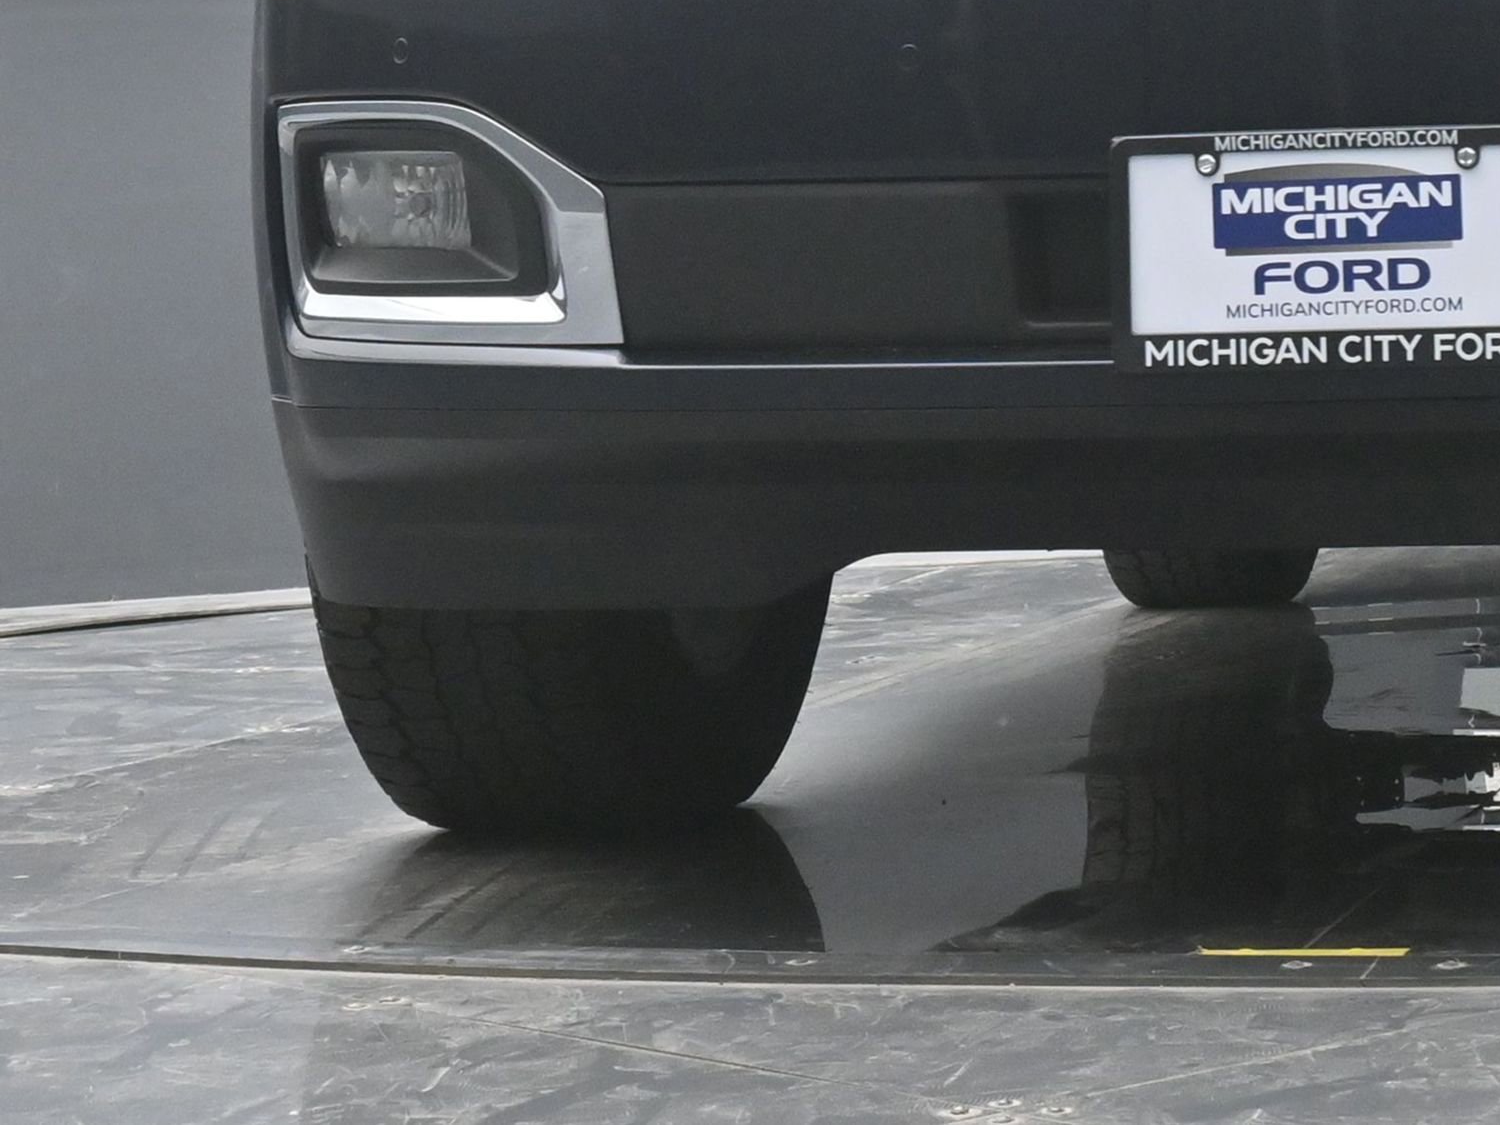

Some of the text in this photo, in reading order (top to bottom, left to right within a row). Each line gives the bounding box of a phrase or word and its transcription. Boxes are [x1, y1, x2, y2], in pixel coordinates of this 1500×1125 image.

[1214, 130, 1459, 151] MICHIGANCITYFORD.COM
[1220, 181, 1453, 215] MICHIGAN
[1284, 212, 1389, 240] CITY
[1254, 258, 1432, 295] FORD
[1226, 297, 1464, 319] MICHIGANCITYFORD.COM
[1145, 337, 1328, 367] MICHIGAN
[1338, 335, 1423, 364] CITY
